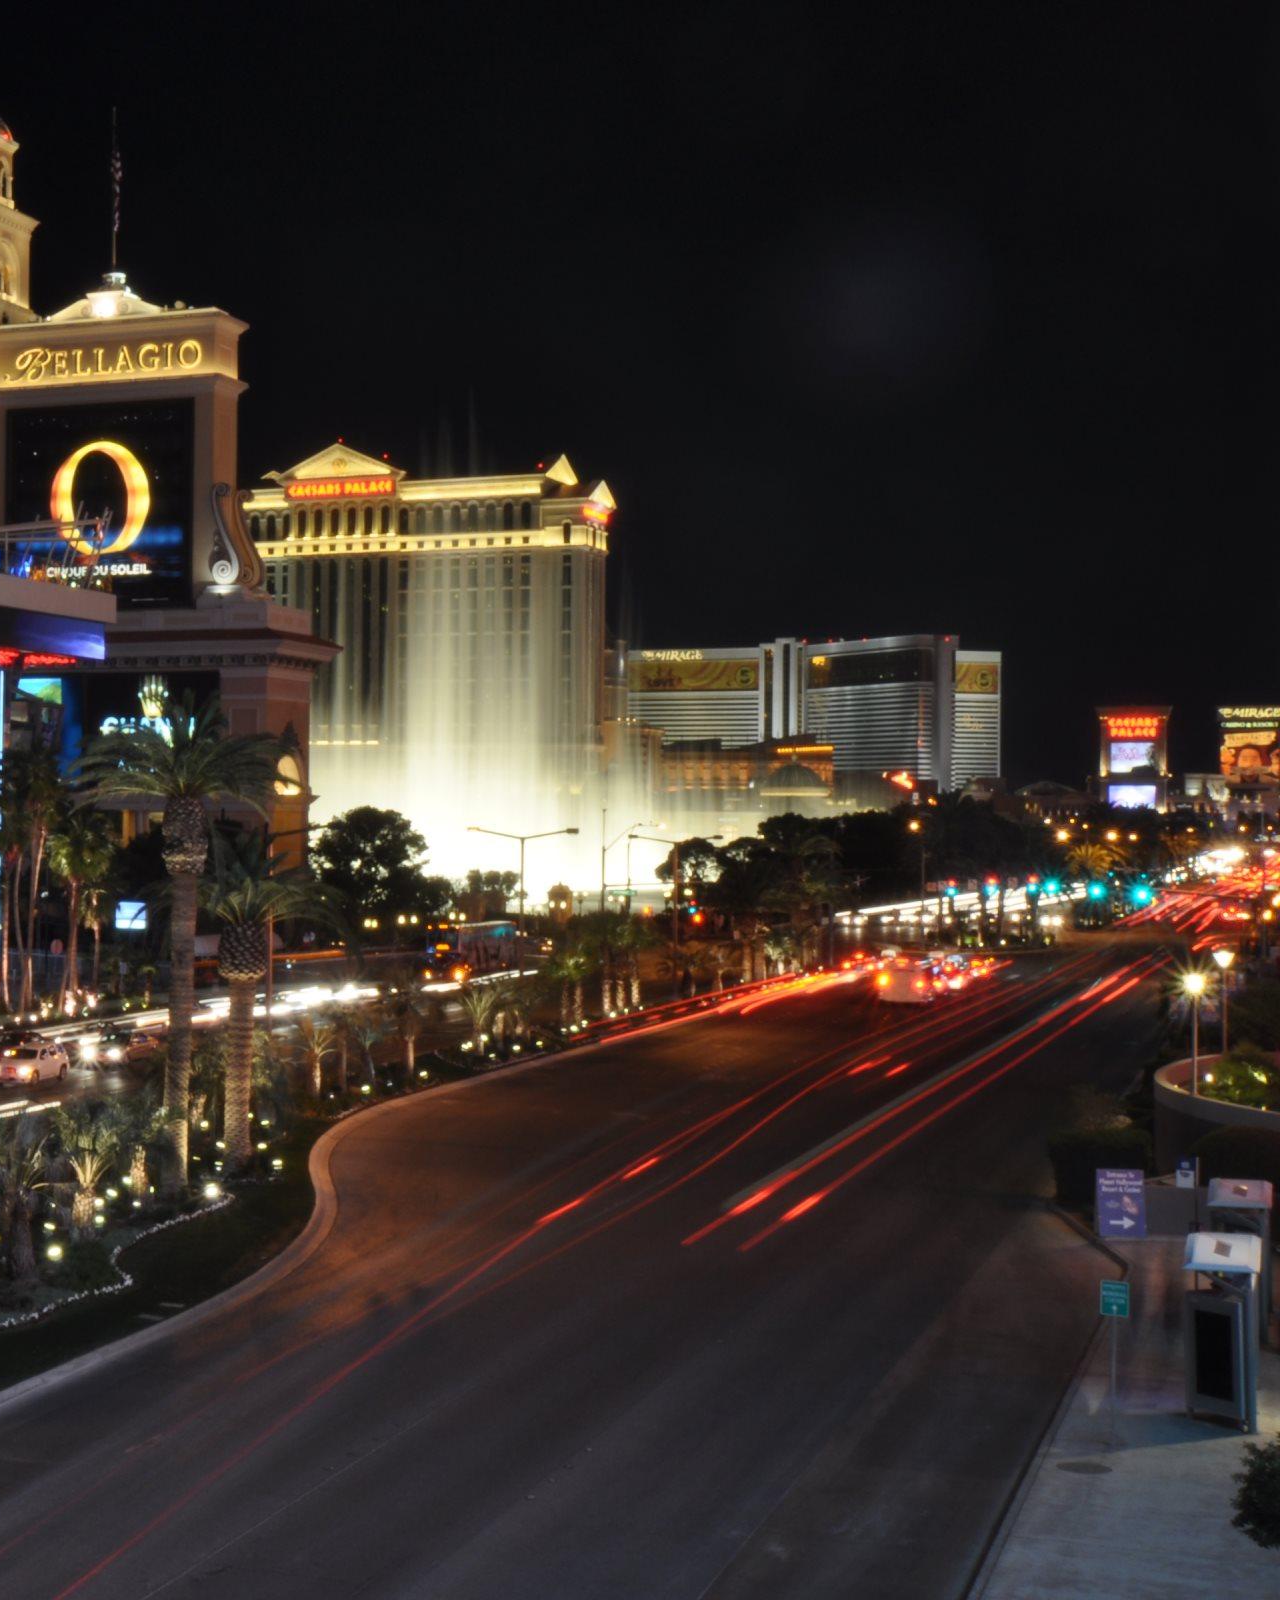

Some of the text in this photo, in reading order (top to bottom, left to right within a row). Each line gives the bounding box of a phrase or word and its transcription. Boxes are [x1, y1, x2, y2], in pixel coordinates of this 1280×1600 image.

[288, 480, 393, 498] CAESARS PALACE
[110, 563, 151, 576] SOLEIL
[655, 649, 704, 662] MIRAGE
[1107, 717, 1159, 728] CAESARS
[1110, 727, 1157, 738] PALACE
